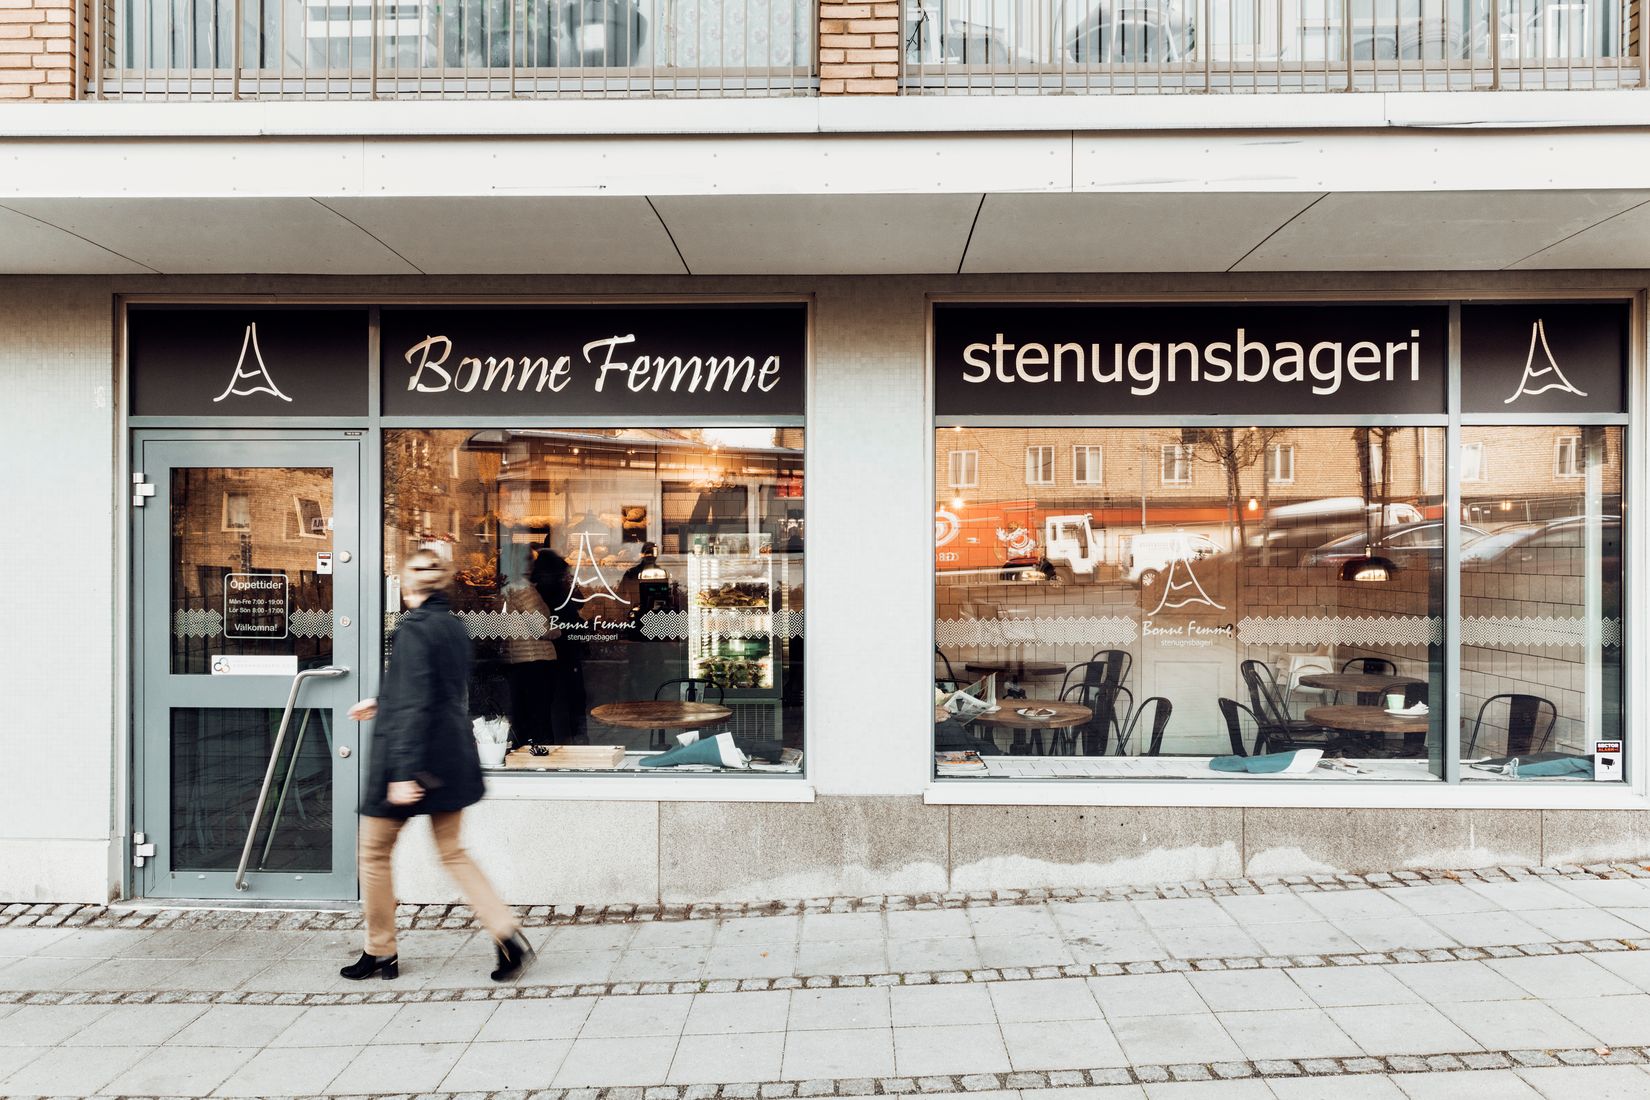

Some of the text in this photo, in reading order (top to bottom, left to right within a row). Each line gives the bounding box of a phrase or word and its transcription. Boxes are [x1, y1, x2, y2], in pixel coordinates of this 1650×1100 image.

[404, 333, 781, 393] Bonne Femme
[962, 328, 1420, 396] stenugnsbageri
[230, 578, 283, 590] Öppettider
[234, 623, 278, 631] Välkomna!
[549, 615, 636, 631] Bonne Femme
[1142, 620, 1233, 637] Bonne Femme
[567, 633, 619, 641] stenugnsbageri
[1160, 639, 1213, 648] stenugnsbageri
